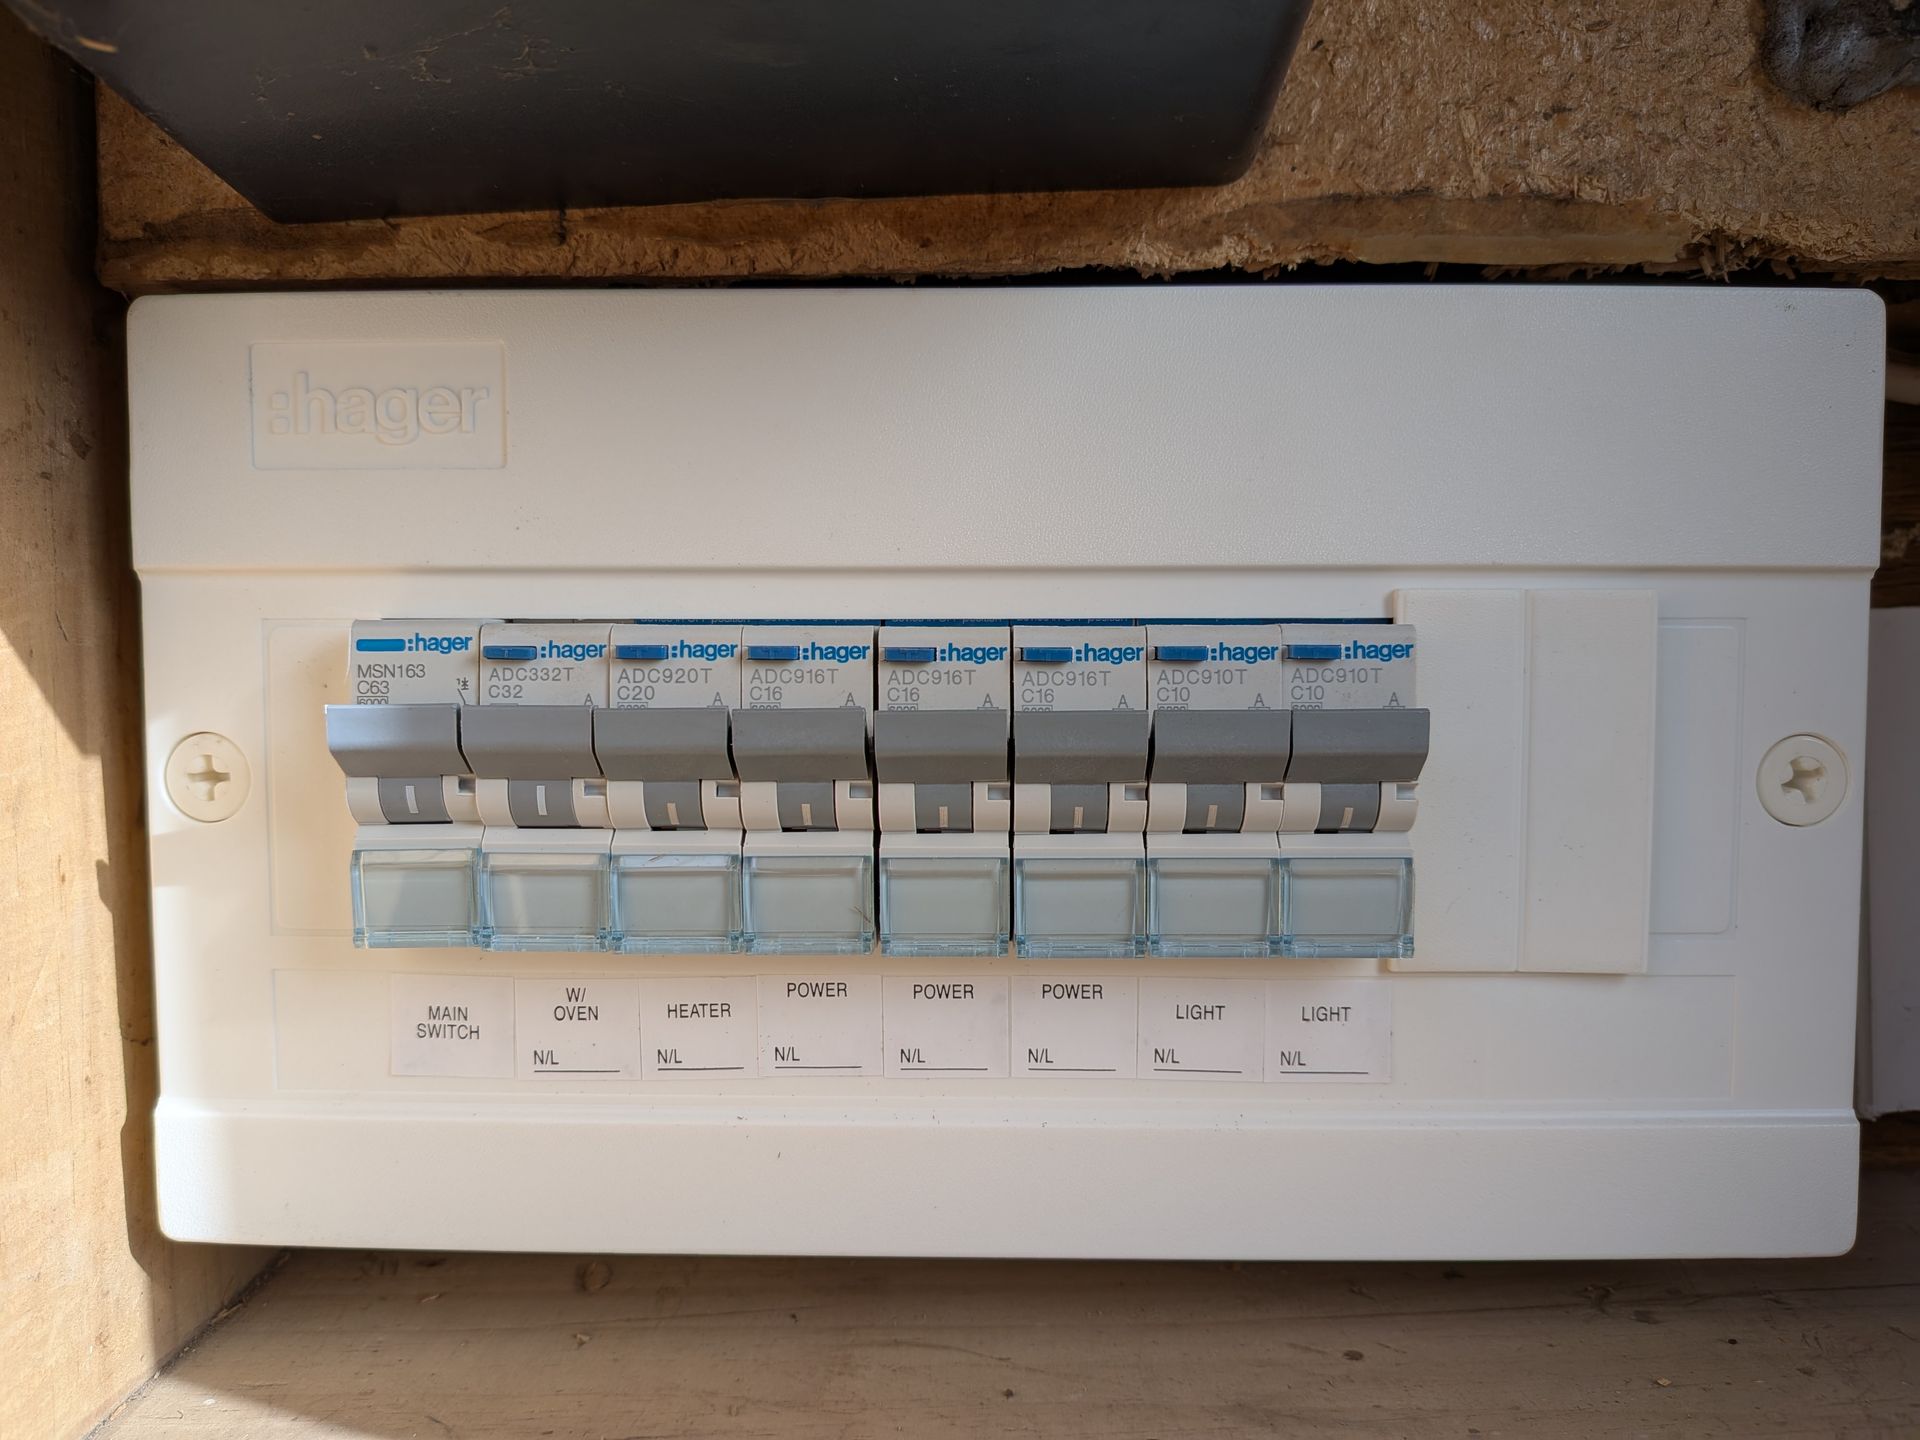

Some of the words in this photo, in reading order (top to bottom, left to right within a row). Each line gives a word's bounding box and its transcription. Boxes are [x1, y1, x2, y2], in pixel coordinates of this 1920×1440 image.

[356, 663, 426, 679] MSN163
[488, 667, 575, 682] ADC332T
[617, 667, 713, 684] ADC920T
[750, 668, 840, 684] ADC916T
[887, 669, 977, 686] ADC916T
[1021, 670, 1112, 687] ADC916T
[1156, 668, 1248, 685] ADC910T
[1290, 667, 1383, 684] ADC910T
[356, 680, 390, 695] C63
[488, 684, 524, 699] C32
[616, 685, 656, 701] C20
[749, 686, 783, 701] C16
[887, 687, 920, 702] C16
[1156, 686, 1191, 702] C10
[1290, 685, 1325, 701] C10
[1021, 688, 1055, 704] C16
[565, 987, 587, 1003] W/
[787, 982, 848, 998] POWER
[913, 984, 974, 1000] POWER
[1042, 984, 1103, 1000] POWER
[428, 1005, 468, 1021] MAIN
[553, 1005, 599, 1021] OVEN
[667, 1002, 732, 1019] HEATER
[1176, 1004, 1226, 1021] LIGHT
[1301, 1006, 1351, 1022] LIGHT
[416, 1023, 480, 1040] SWITCH
[533, 1050, 559, 1065] N/L
[657, 1049, 683, 1064] N/L
[774, 1047, 800, 1062] N/L
[900, 1048, 926, 1064] N/L
[1028, 1048, 1054, 1064] N/L
[1153, 1048, 1180, 1064] N/L
[1280, 1050, 1307, 1066] N/L
